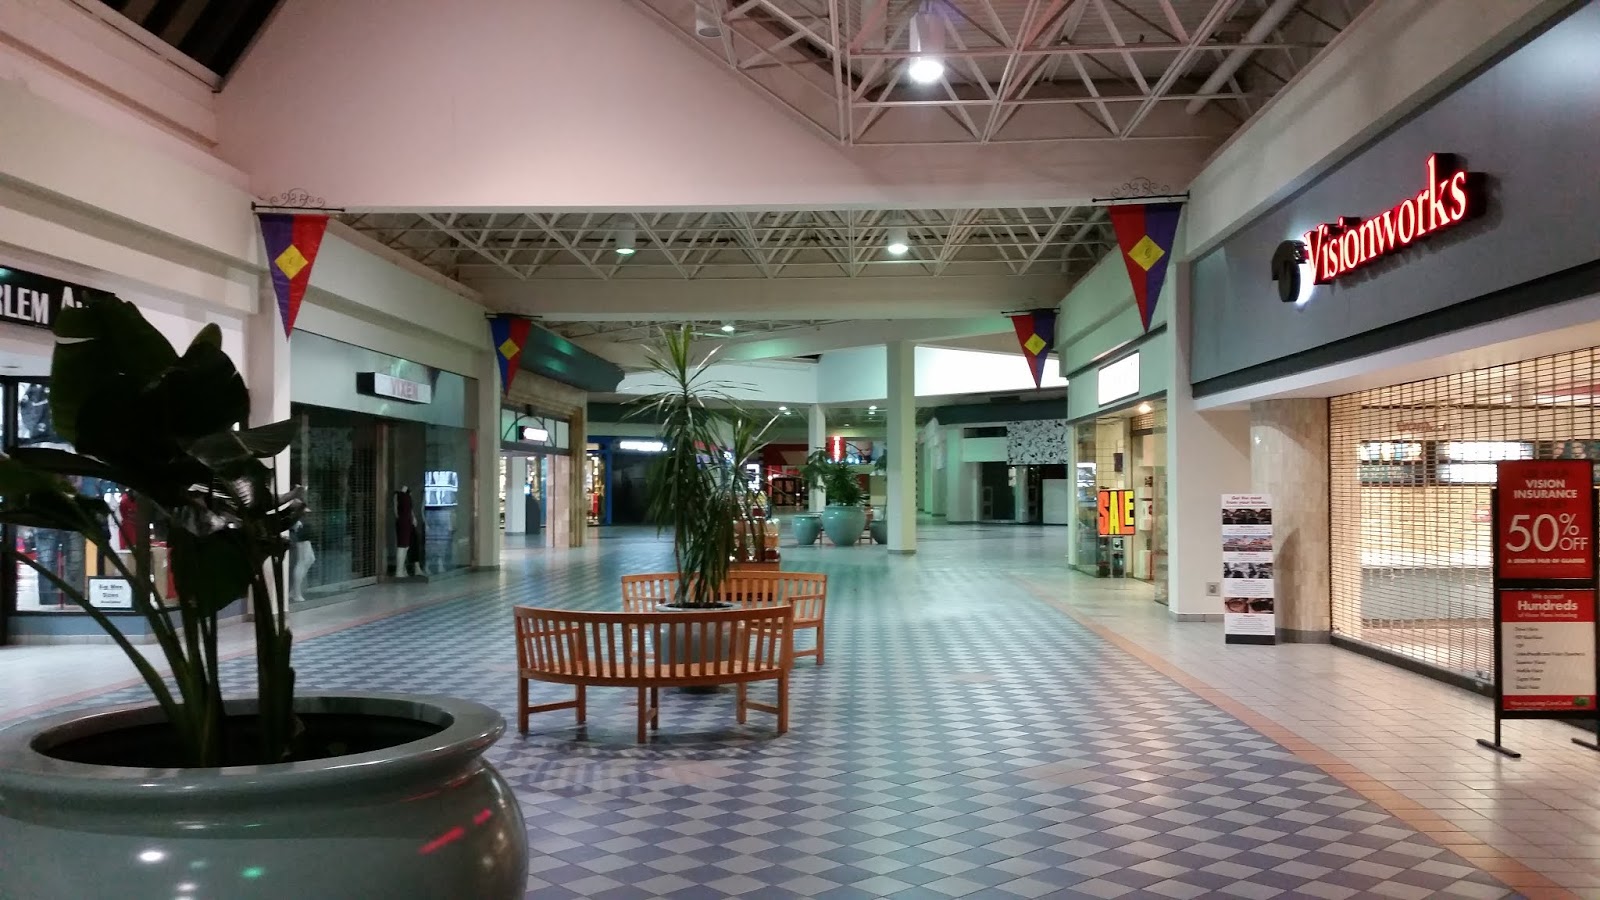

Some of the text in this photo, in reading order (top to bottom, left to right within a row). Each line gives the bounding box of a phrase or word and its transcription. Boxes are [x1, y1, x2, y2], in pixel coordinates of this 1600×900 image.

[1303, 153, 1468, 286] Visionworks
[1525, 480, 1566, 488] VISION
[1513, 490, 1578, 498] INSURANCE
[1098, 490, 1135, 535] SALE
[1505, 513, 1580, 552] 50%
[1559, 537, 1588, 550] OFF
[1517, 600, 1578, 611] Hundreds
